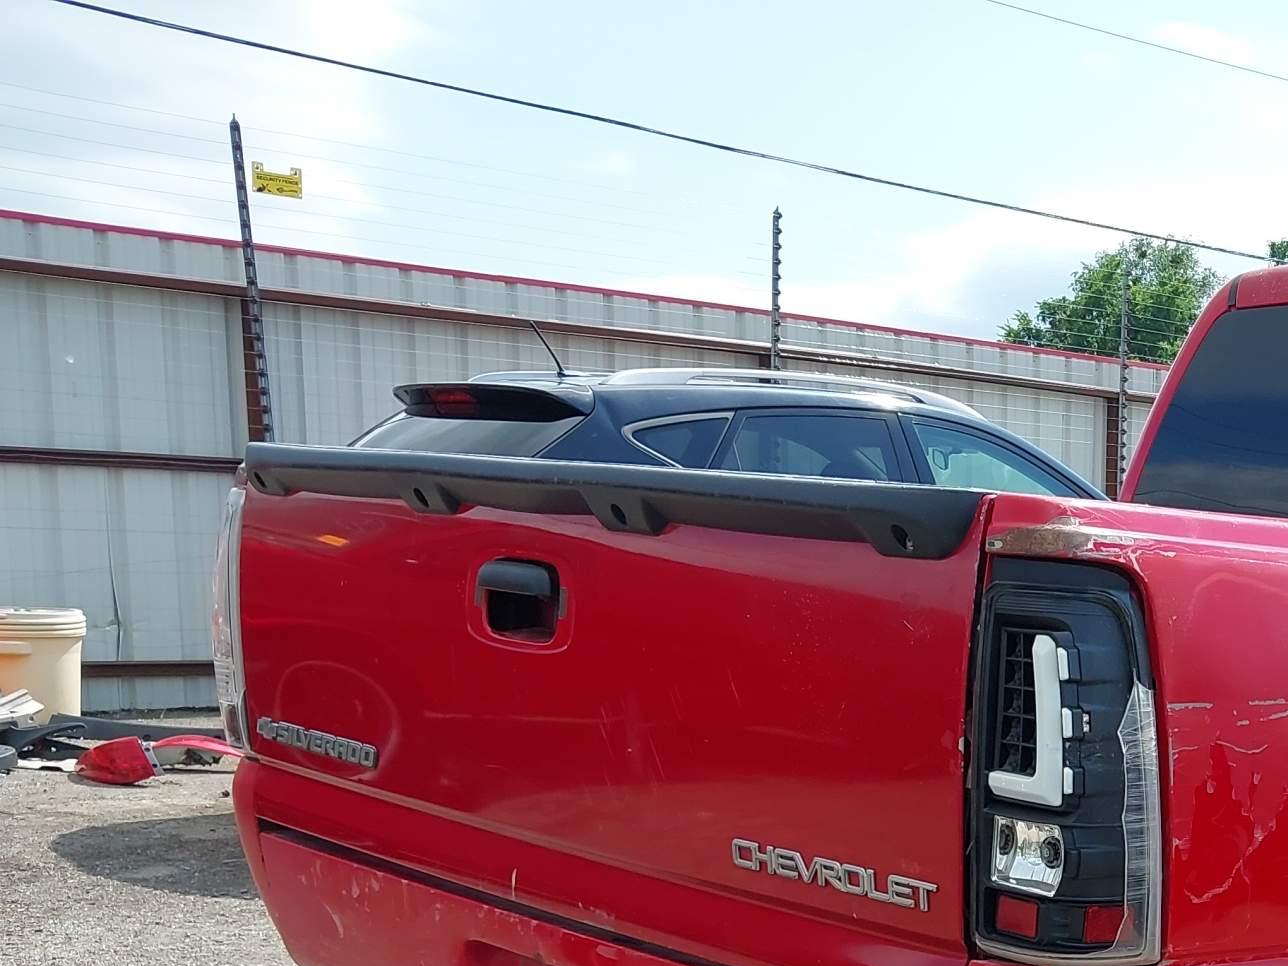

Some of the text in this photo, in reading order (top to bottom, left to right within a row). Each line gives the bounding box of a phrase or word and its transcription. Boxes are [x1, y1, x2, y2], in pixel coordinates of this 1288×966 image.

[256, 175, 281, 183] SECURITY
[277, 721, 377, 767] SILVERADO
[732, 838, 938, 912] CHEVROLET
